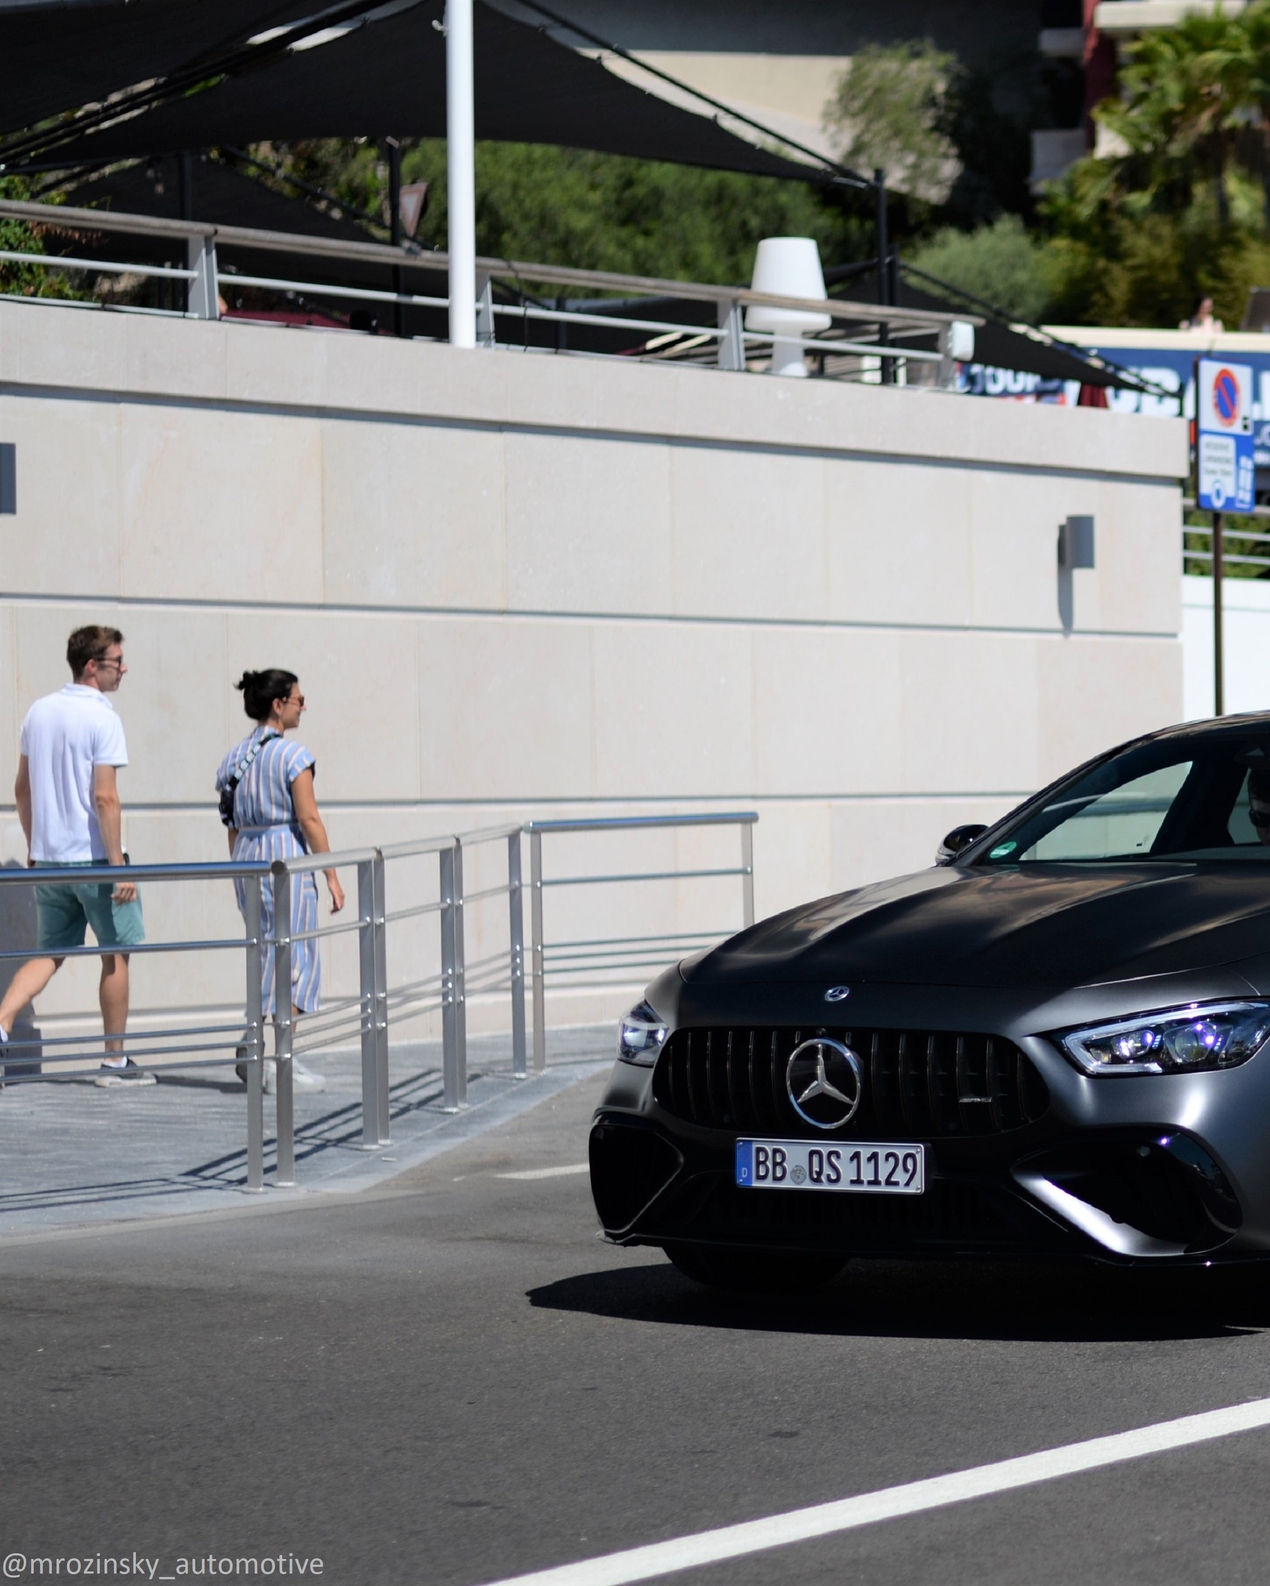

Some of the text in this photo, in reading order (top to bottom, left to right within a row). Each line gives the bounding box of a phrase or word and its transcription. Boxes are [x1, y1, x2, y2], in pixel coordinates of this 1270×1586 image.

[741, 1146, 918, 1187] D BB QS 1129
